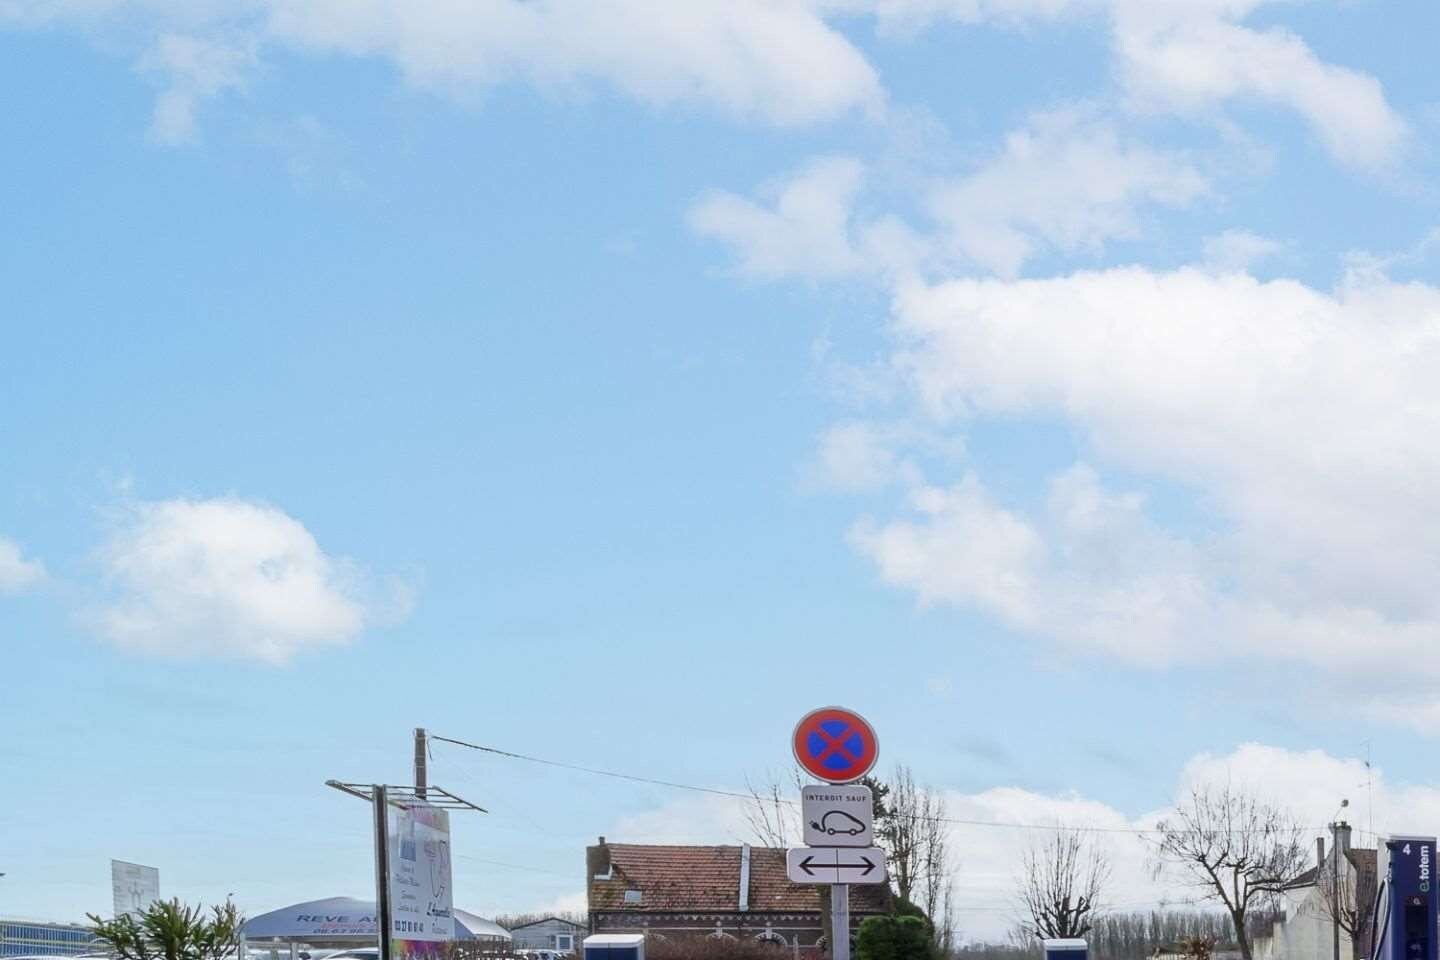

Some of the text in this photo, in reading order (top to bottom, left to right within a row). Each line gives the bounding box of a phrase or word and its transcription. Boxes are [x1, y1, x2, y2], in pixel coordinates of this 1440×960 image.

[805, 794, 867, 803] INTERDIT SAUF
[1402, 843, 1411, 855] 4
